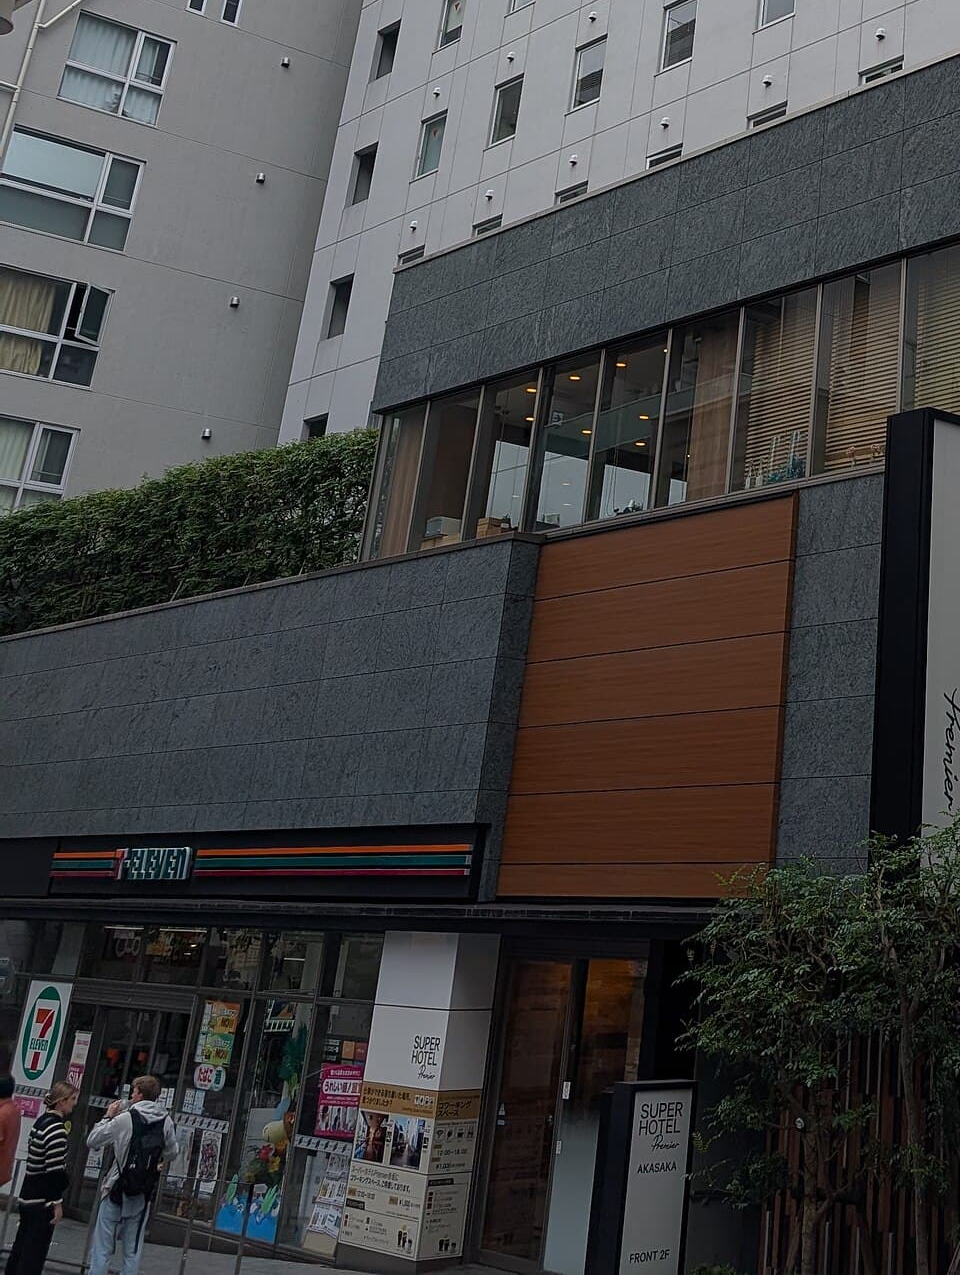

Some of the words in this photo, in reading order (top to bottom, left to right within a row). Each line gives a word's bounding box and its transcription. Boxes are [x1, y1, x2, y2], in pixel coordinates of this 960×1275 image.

[413, 1035, 441, 1051] SUPER
[411, 1050, 437, 1066] HOTEL
[640, 1102, 683, 1119] SUPER
[638, 1118, 681, 1136] HOTEL
[651, 1133, 680, 1152] Premier
[637, 1161, 677, 1174] AKASAKA
[629, 1250, 659, 1264] FRONT
[659, 1249, 670, 1261] 2F
